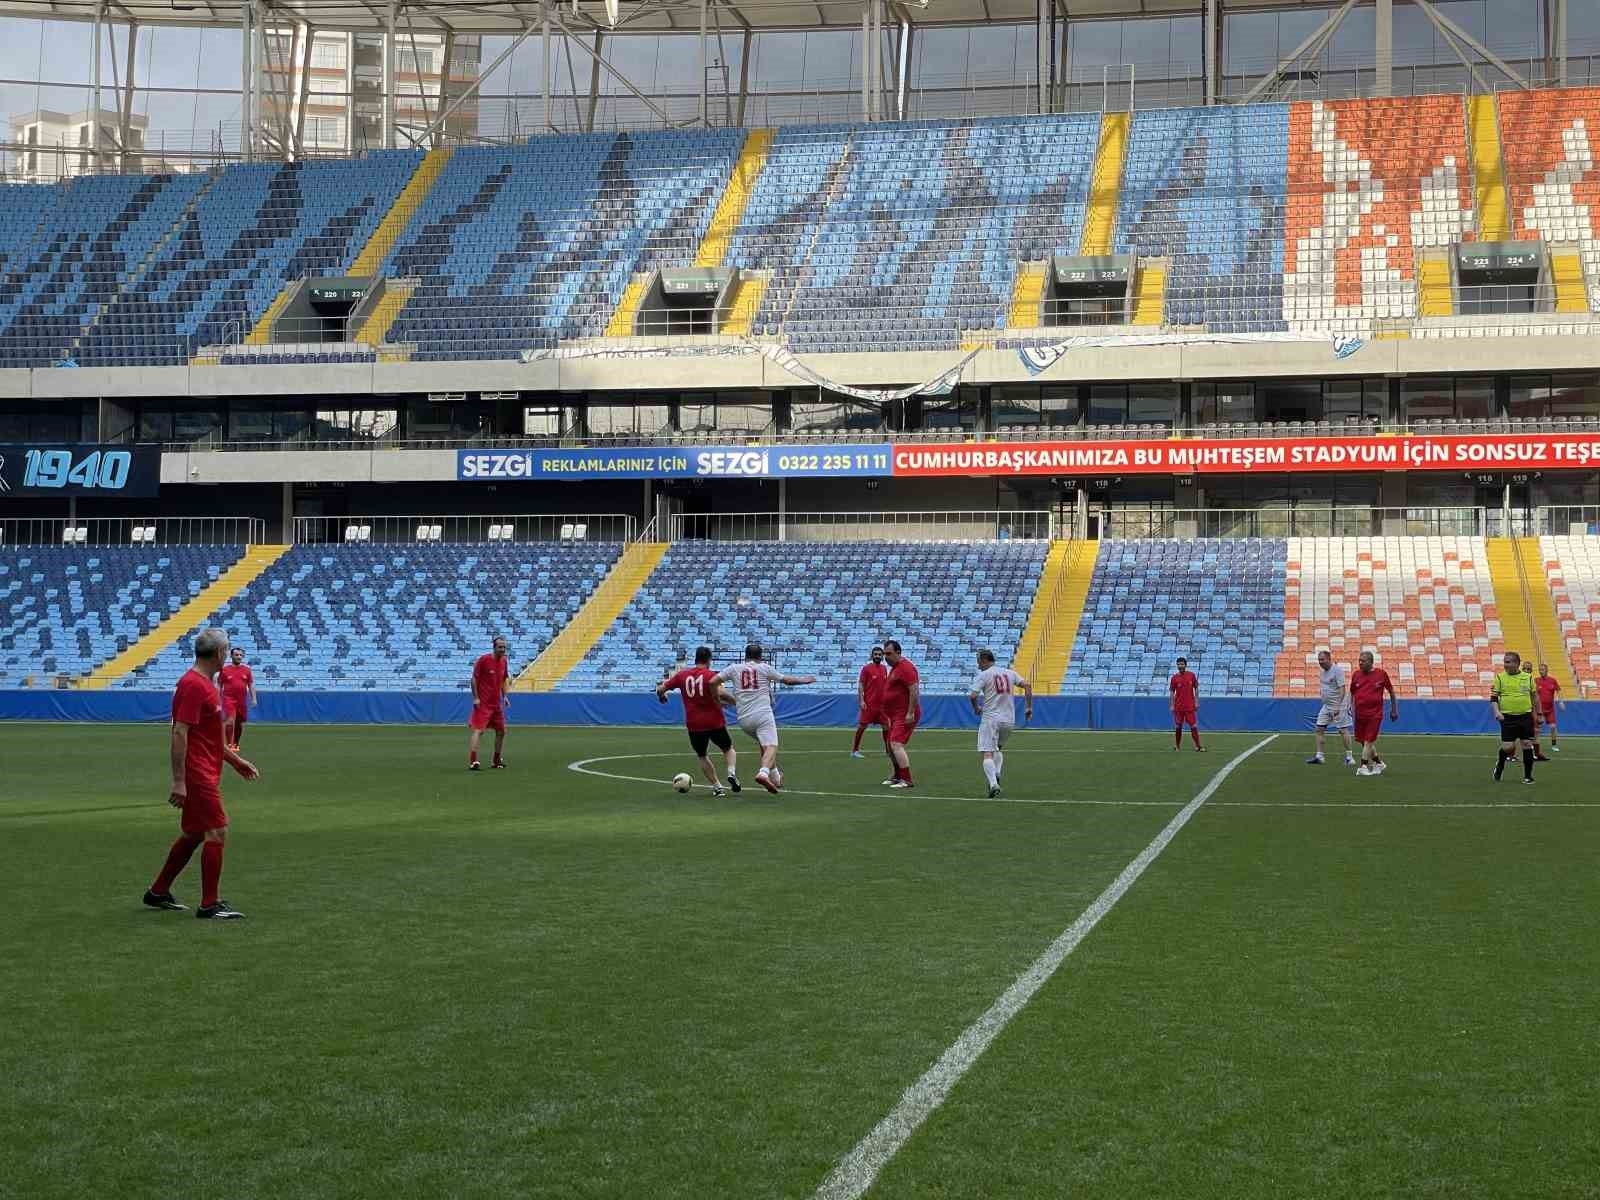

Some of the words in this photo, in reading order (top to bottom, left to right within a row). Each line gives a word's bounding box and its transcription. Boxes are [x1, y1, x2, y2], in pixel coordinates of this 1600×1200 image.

[462, 451, 533, 478] SEZGİ
[542, 457, 655, 472] REKLAMLARINIZ
[658, 455, 687, 472] İÇİN
[696, 448, 769, 475] SEZGİ
[779, 455, 819, 470] 0322
[822, 455, 851, 469] 235
[855, 454, 868, 469] 11
[873, 454, 887, 468] 11
[896, 448, 1129, 471] CUMHURBAŞKANIMIZA
[1134, 448, 1162, 465] BU
[1168, 446, 1285, 469] MUHTEŞEM
[1290, 444, 1397, 463] STADYUM
[1403, 440, 1449, 466] İÇİN
[1456, 443, 1547, 461] SONSUZ
[24, 449, 131, 489] 1940
[685, 675, 704, 698] 01
[741, 669, 758, 690] 01
[995, 674, 1011, 695] 01
